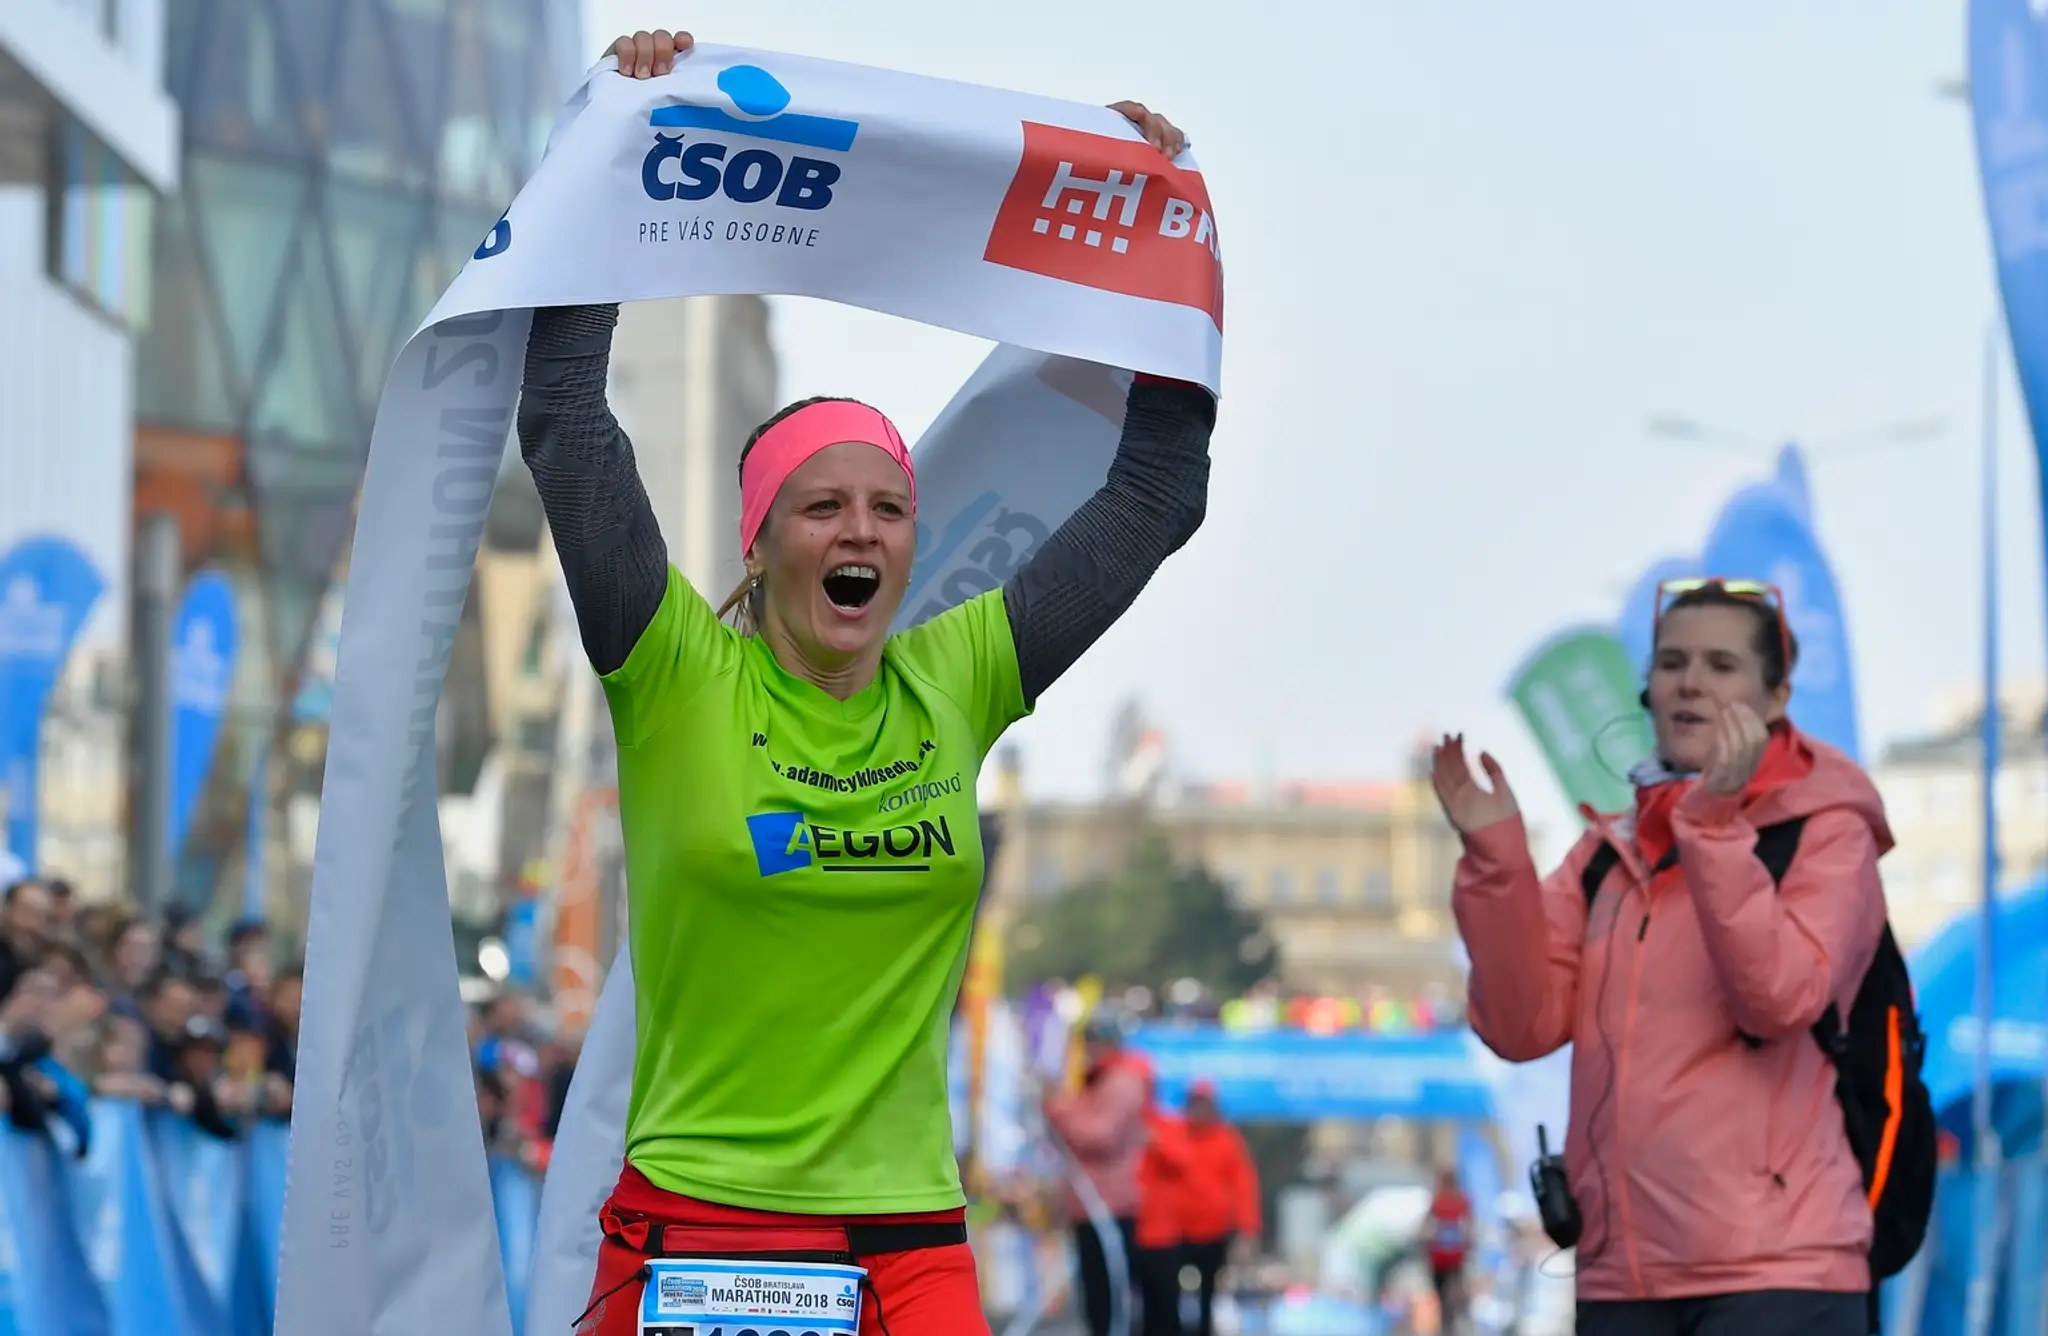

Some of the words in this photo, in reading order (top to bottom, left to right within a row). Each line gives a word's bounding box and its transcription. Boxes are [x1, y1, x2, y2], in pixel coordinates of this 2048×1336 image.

[641, 131, 841, 211] ČSOB
[639, 222, 669, 244] PRE
[678, 216, 715, 241] VÁS
[726, 221, 820, 247] OSOBNE
[785, 815, 956, 858] AEGON
[712, 1288, 791, 1304] MARATHON
[795, 1293, 828, 1308] 2018
[734, 1275, 762, 1289] ČSOB
[763, 1281, 805, 1290] BRATISLAVA
